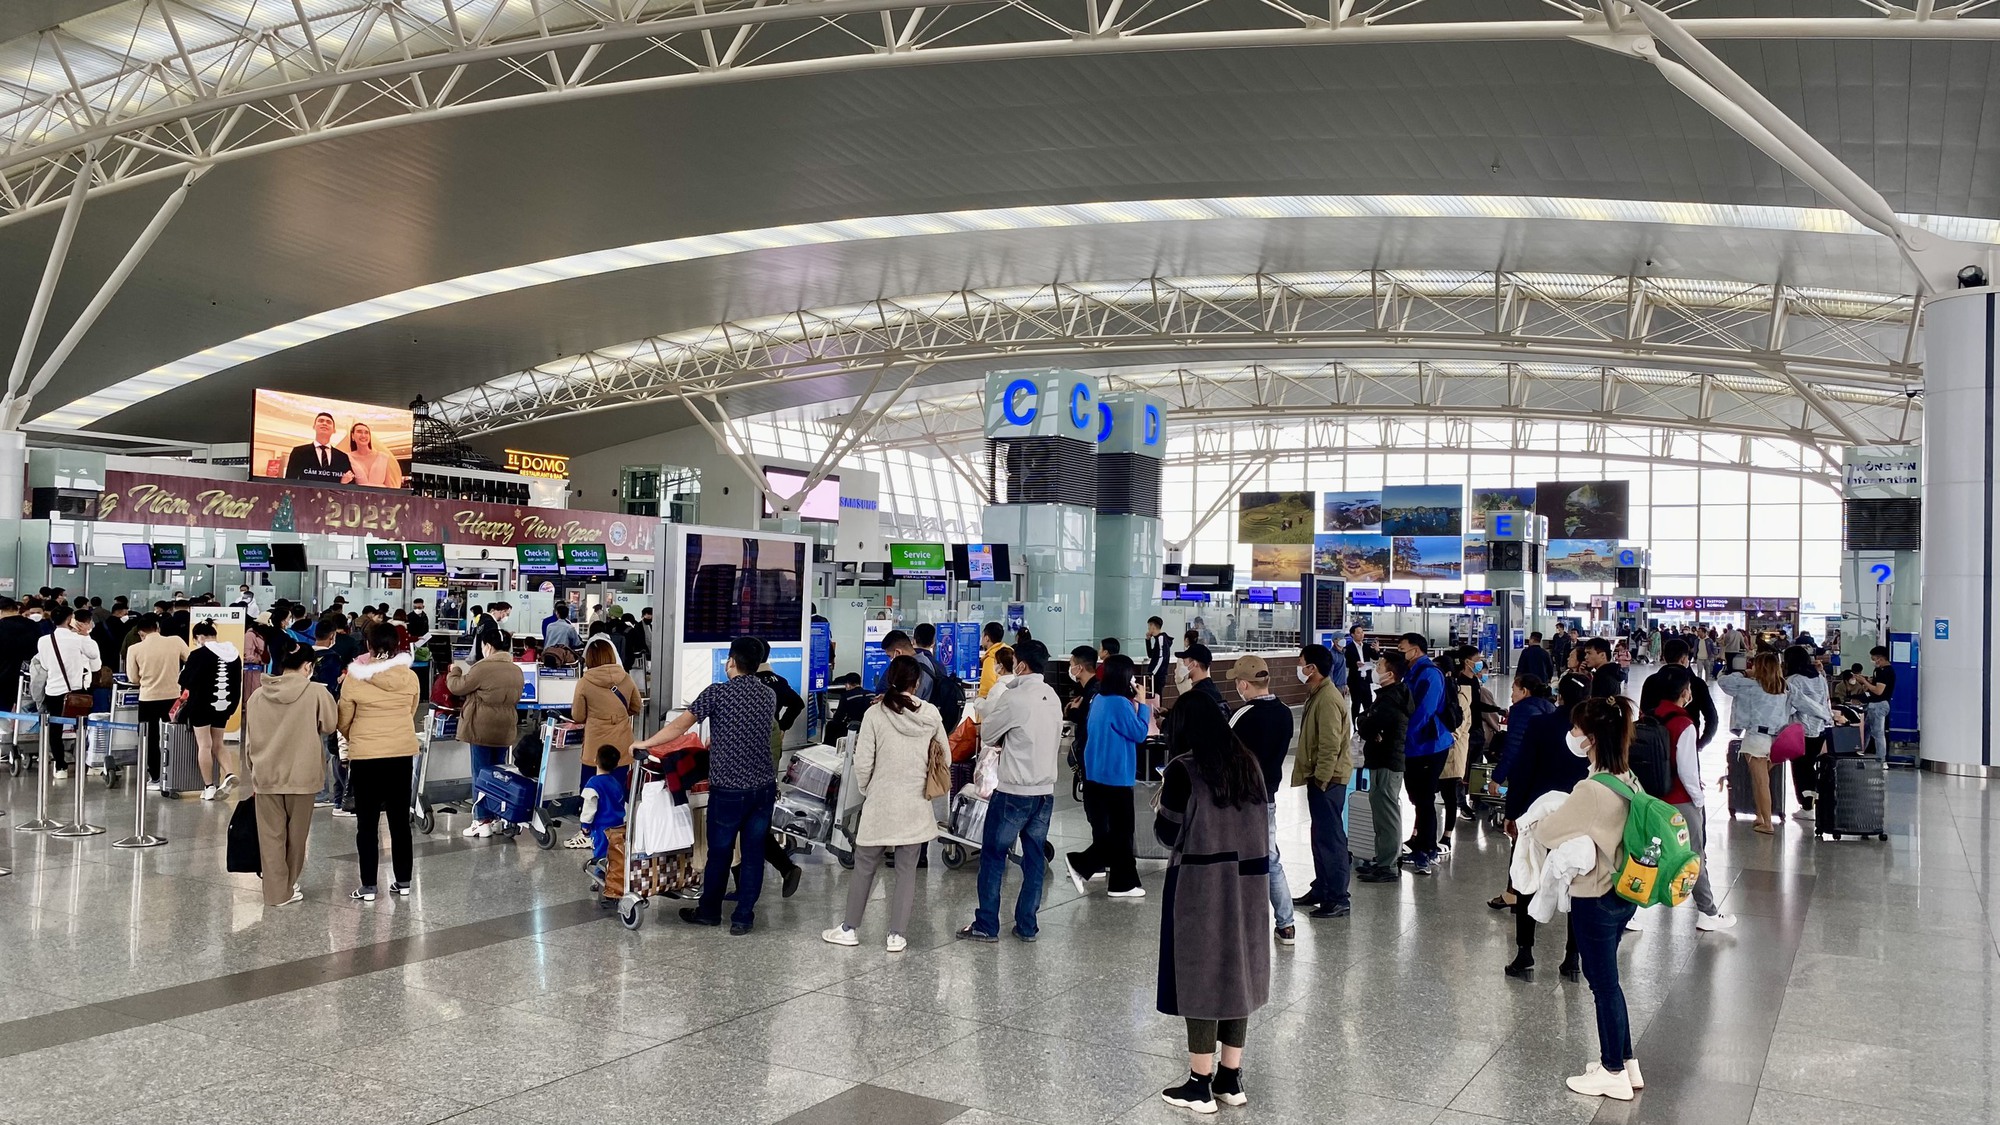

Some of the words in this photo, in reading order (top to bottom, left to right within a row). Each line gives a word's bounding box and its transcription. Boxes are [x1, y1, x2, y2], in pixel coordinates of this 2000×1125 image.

[1003, 378, 1038, 426] C
[1070, 382, 1091, 429] C
[1144, 404, 1161, 446] D
[508, 454, 520, 465] EL
[522, 456, 566, 473] DOMO
[128, 484, 189, 514] Năm
[840, 496, 877, 511] SAMSUNG
[325, 502, 401, 530] 2023
[453, 510, 516, 544] Happy
[521, 516, 562, 539] New
[563, 520, 603, 544] Year
[1496, 514, 1512, 536] E
[1619, 550, 1634, 565] G
